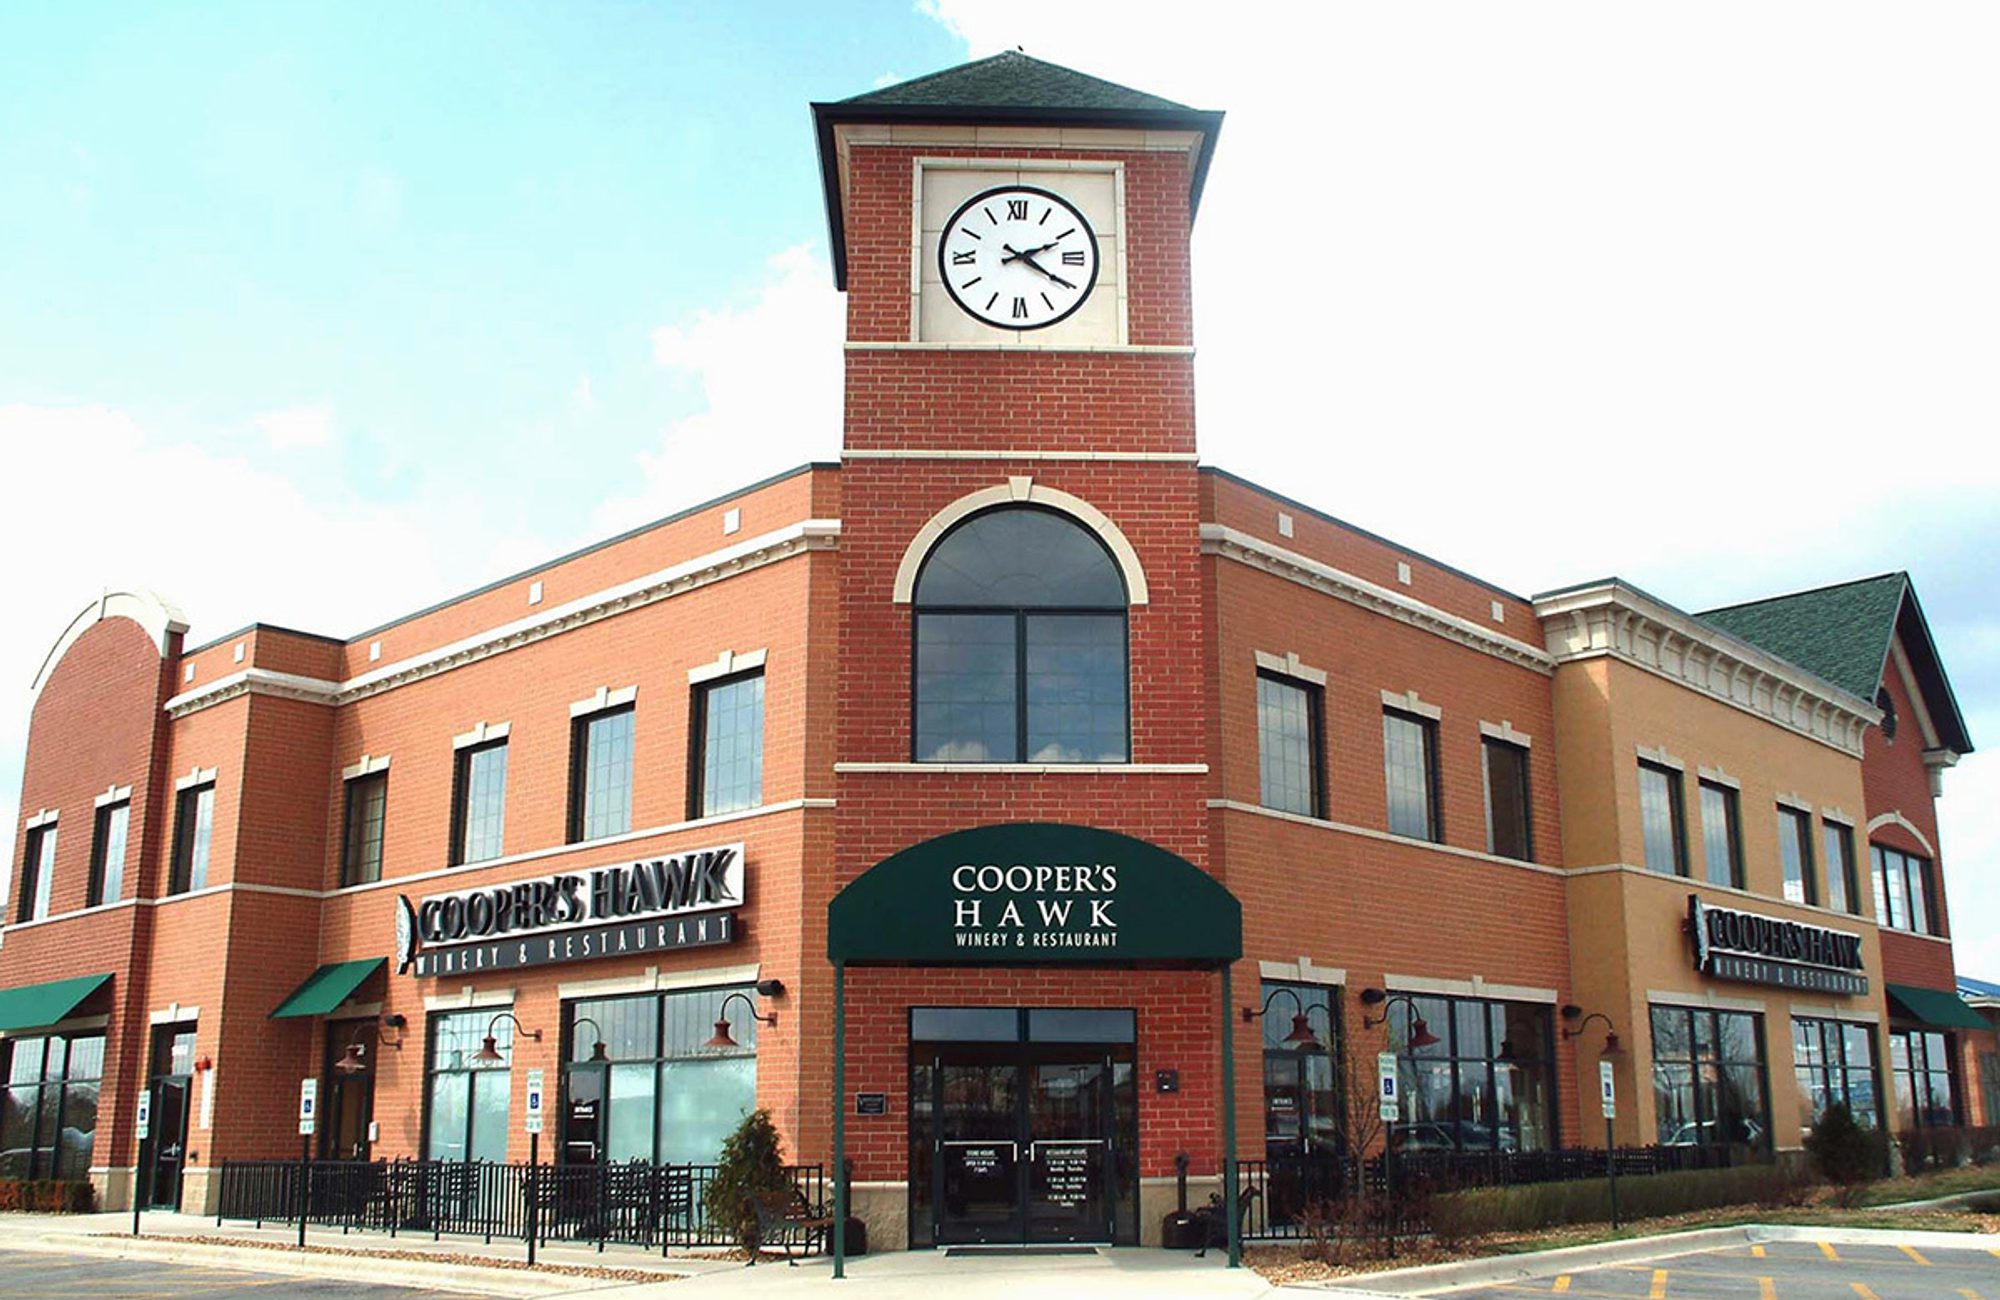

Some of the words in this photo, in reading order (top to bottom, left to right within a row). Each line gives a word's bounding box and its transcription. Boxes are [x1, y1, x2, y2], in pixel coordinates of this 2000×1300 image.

[417, 875, 586, 942] COOPER'S
[589, 849, 738, 919] HAWK
[952, 865, 1117, 892] COOPER'S
[954, 899, 1117, 927] HAWK
[416, 947, 499, 974] WINERY
[519, 943, 527, 963] &
[549, 917, 728, 958] RESTAURANT
[956, 933, 1008, 946] WINERY
[1016, 933, 1024, 946] &
[1033, 933, 1117, 946] RESTAURANT
[1803, 926, 1864, 969] HAWK
[1714, 957, 1768, 981] WINERY
[1793, 969, 1867, 994] RESTAURANT
